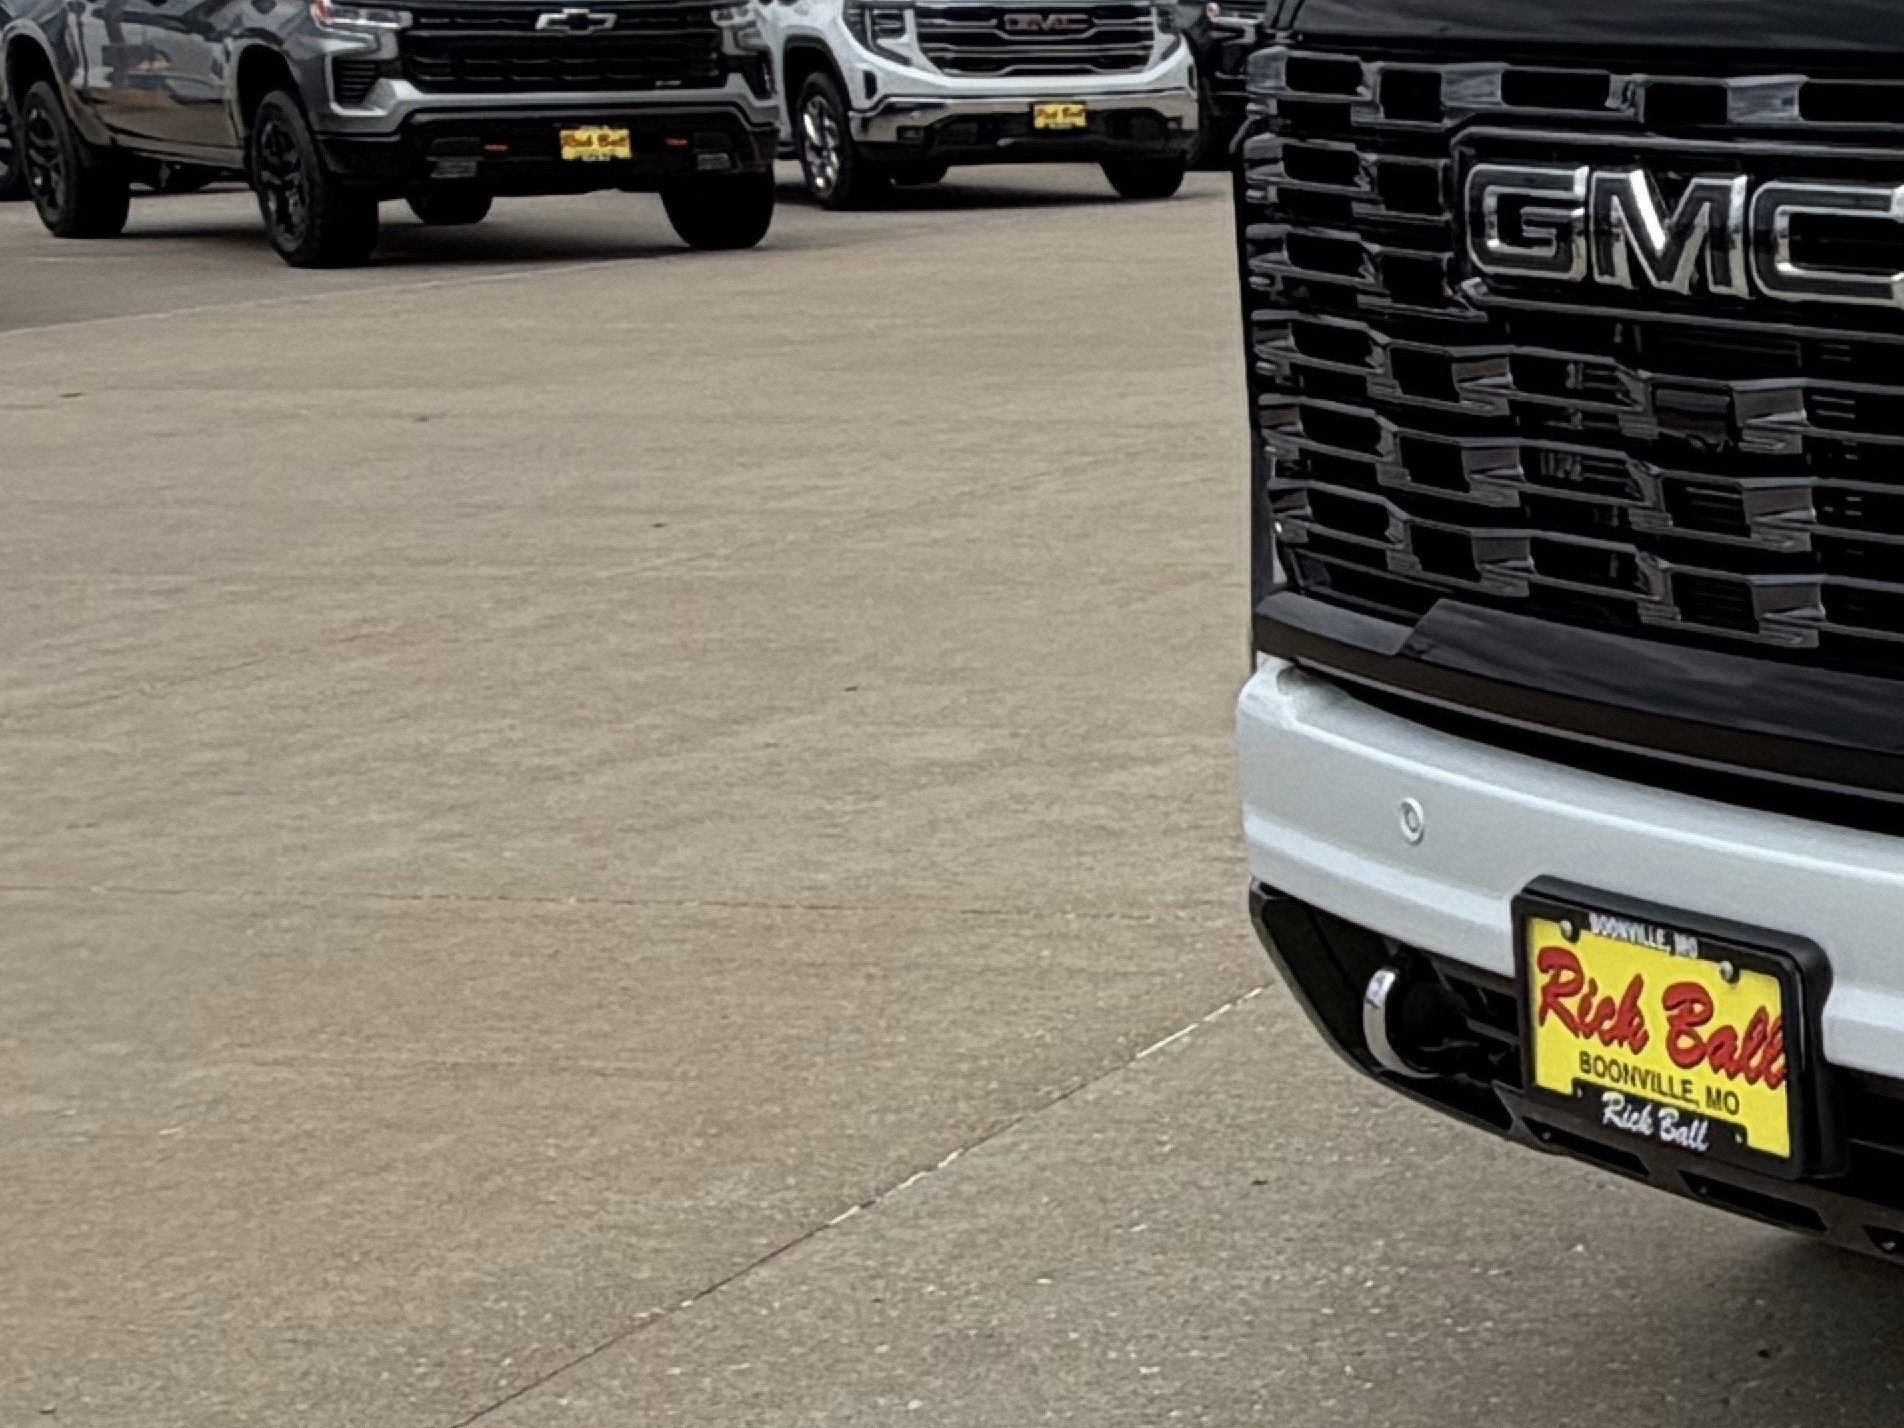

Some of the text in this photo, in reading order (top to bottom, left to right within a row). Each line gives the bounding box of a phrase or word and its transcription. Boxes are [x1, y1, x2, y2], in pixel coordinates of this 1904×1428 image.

[1536, 946, 1788, 1090] Rick Ball
[1578, 1050, 1741, 1116] BOONVILLE, MO
[1600, 1090, 1710, 1153] Rick Ball
